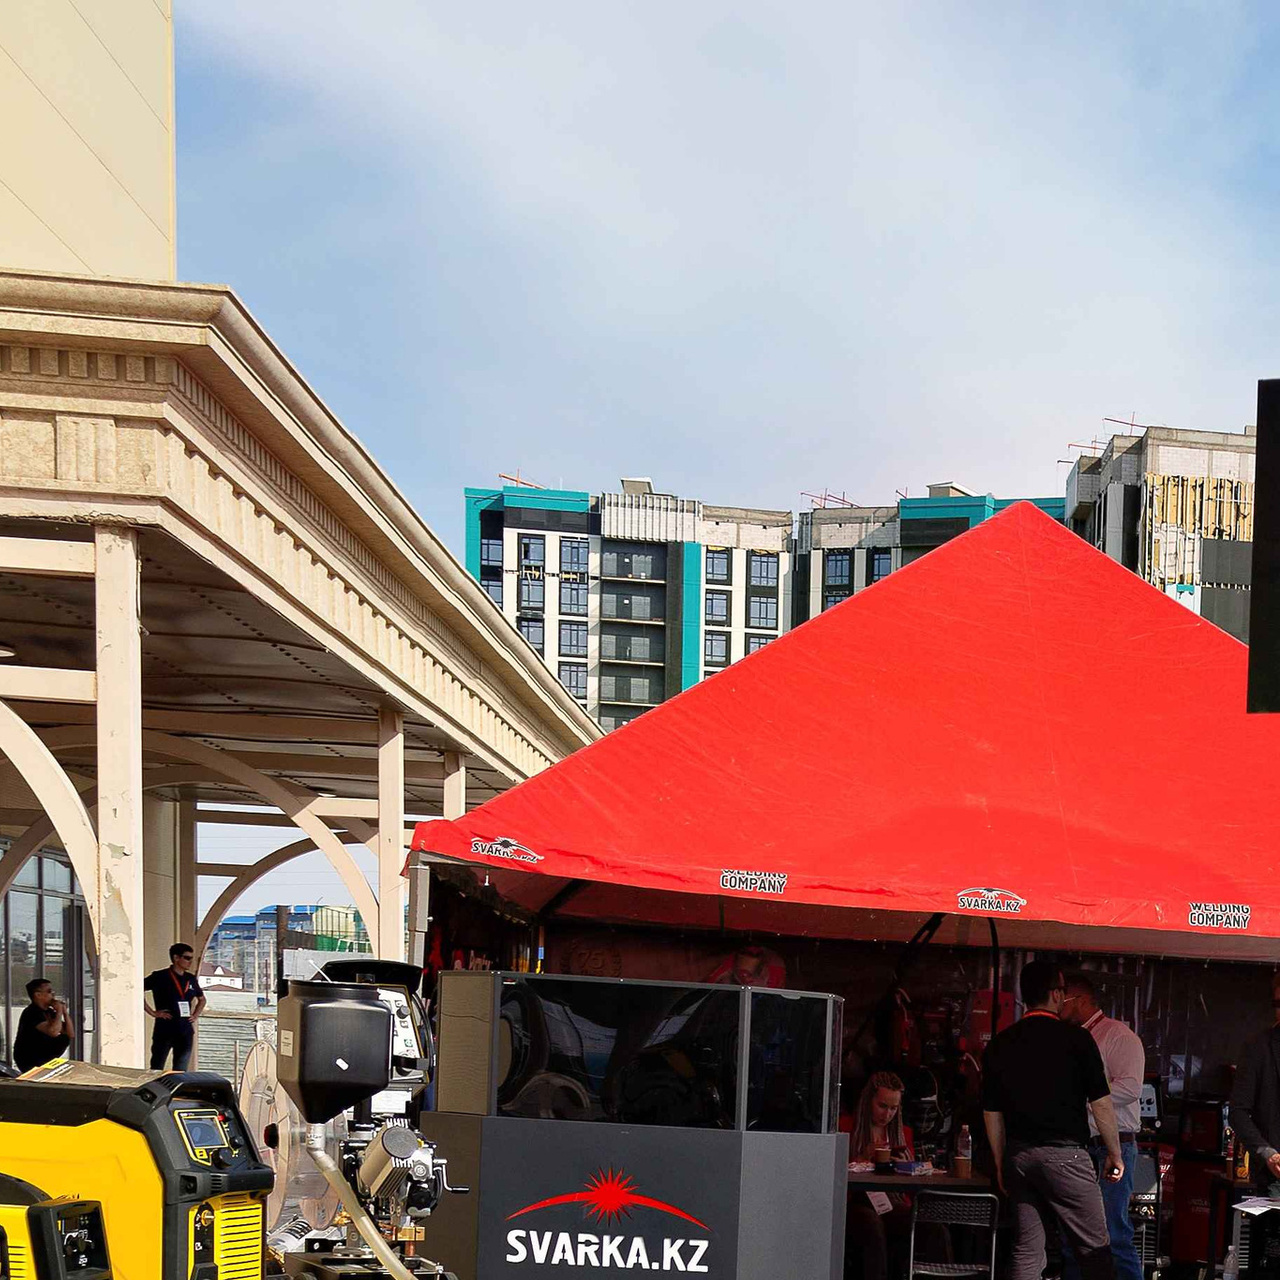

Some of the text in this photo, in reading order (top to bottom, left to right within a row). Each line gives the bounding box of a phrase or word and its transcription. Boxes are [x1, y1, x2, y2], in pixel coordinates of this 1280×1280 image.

[721, 875, 786, 893] COMPANY
[958, 896, 1021, 912] SVARKA.KZ
[1189, 912, 1249, 928] COMPANY
[505, 1228, 711, 1277] SVARKA.KZ
